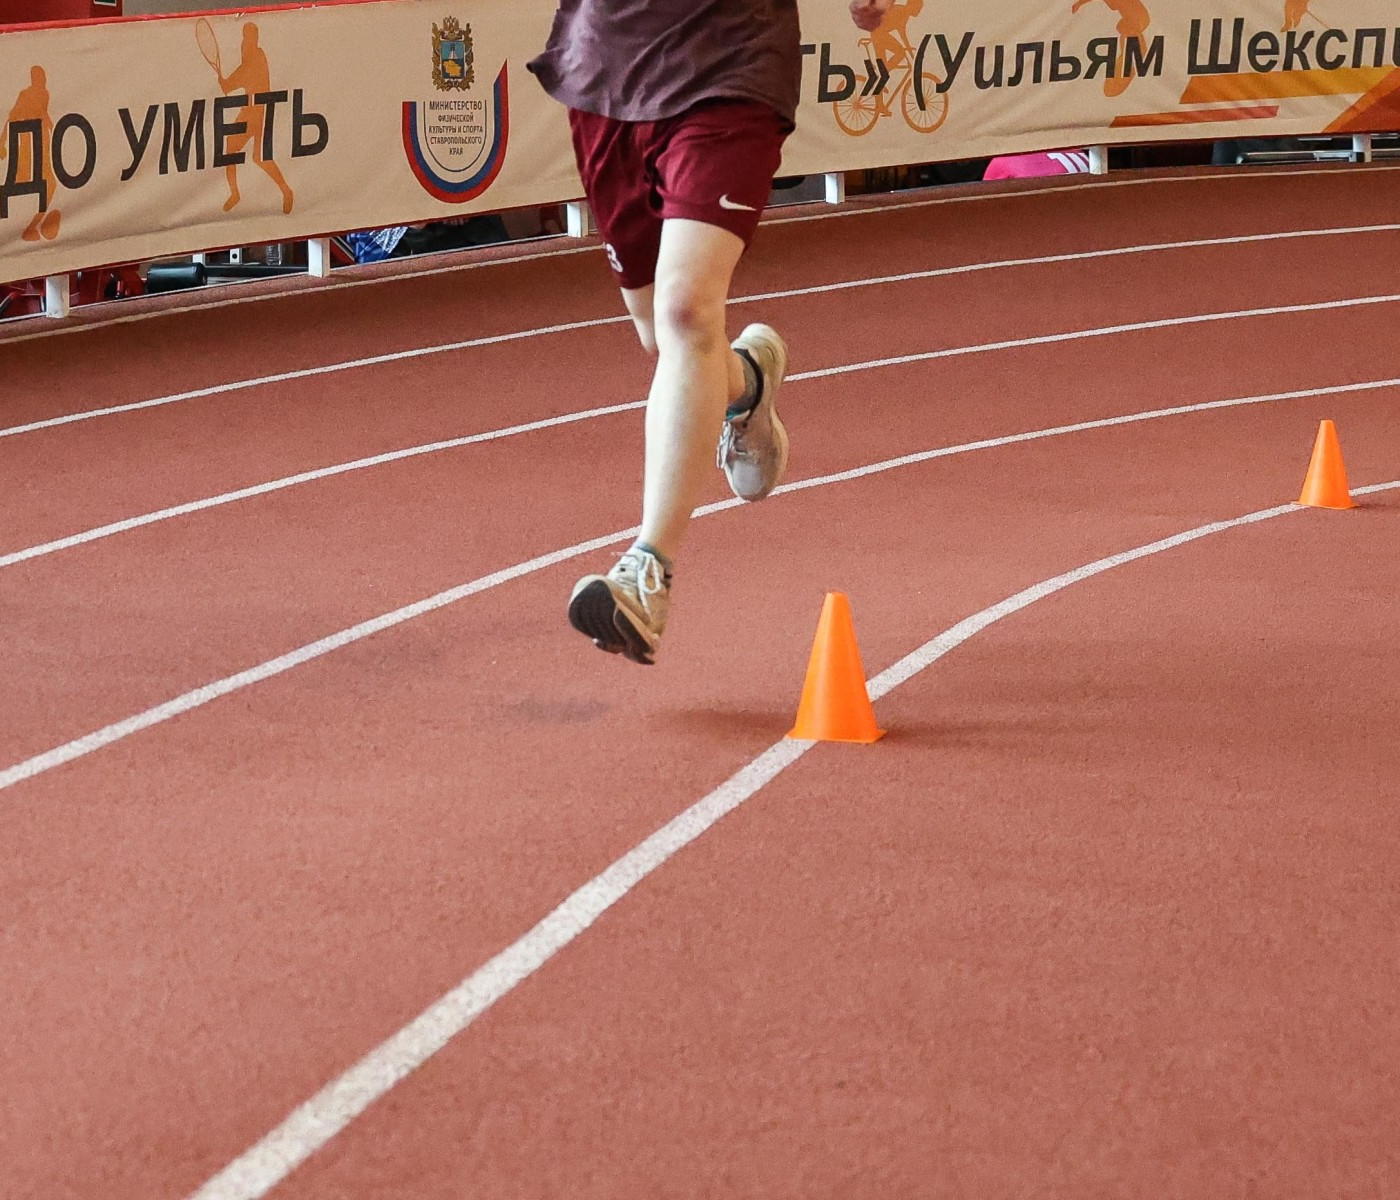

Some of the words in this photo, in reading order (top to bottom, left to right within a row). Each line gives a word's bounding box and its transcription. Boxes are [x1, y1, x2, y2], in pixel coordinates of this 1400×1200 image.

[800, 43, 890, 103] Ь»
[914, 31, 1165, 112] (Уильям
[1187, 17, 1400, 75] Шексп
[429, 100, 482, 110] МИНИСТЕРСТВО
[438, 112, 474, 122] ФИЗИЧЕСКОЙ
[429, 125, 457, 133] КУЛЬТУРЫ
[463, 125, 483, 133] СПОРТА
[118, 88, 331, 183] УМЕТЬ
[430, 136, 482, 144] СТАВРОПОЛЬСКОГО
[449, 147, 463, 155] КРАЯ
